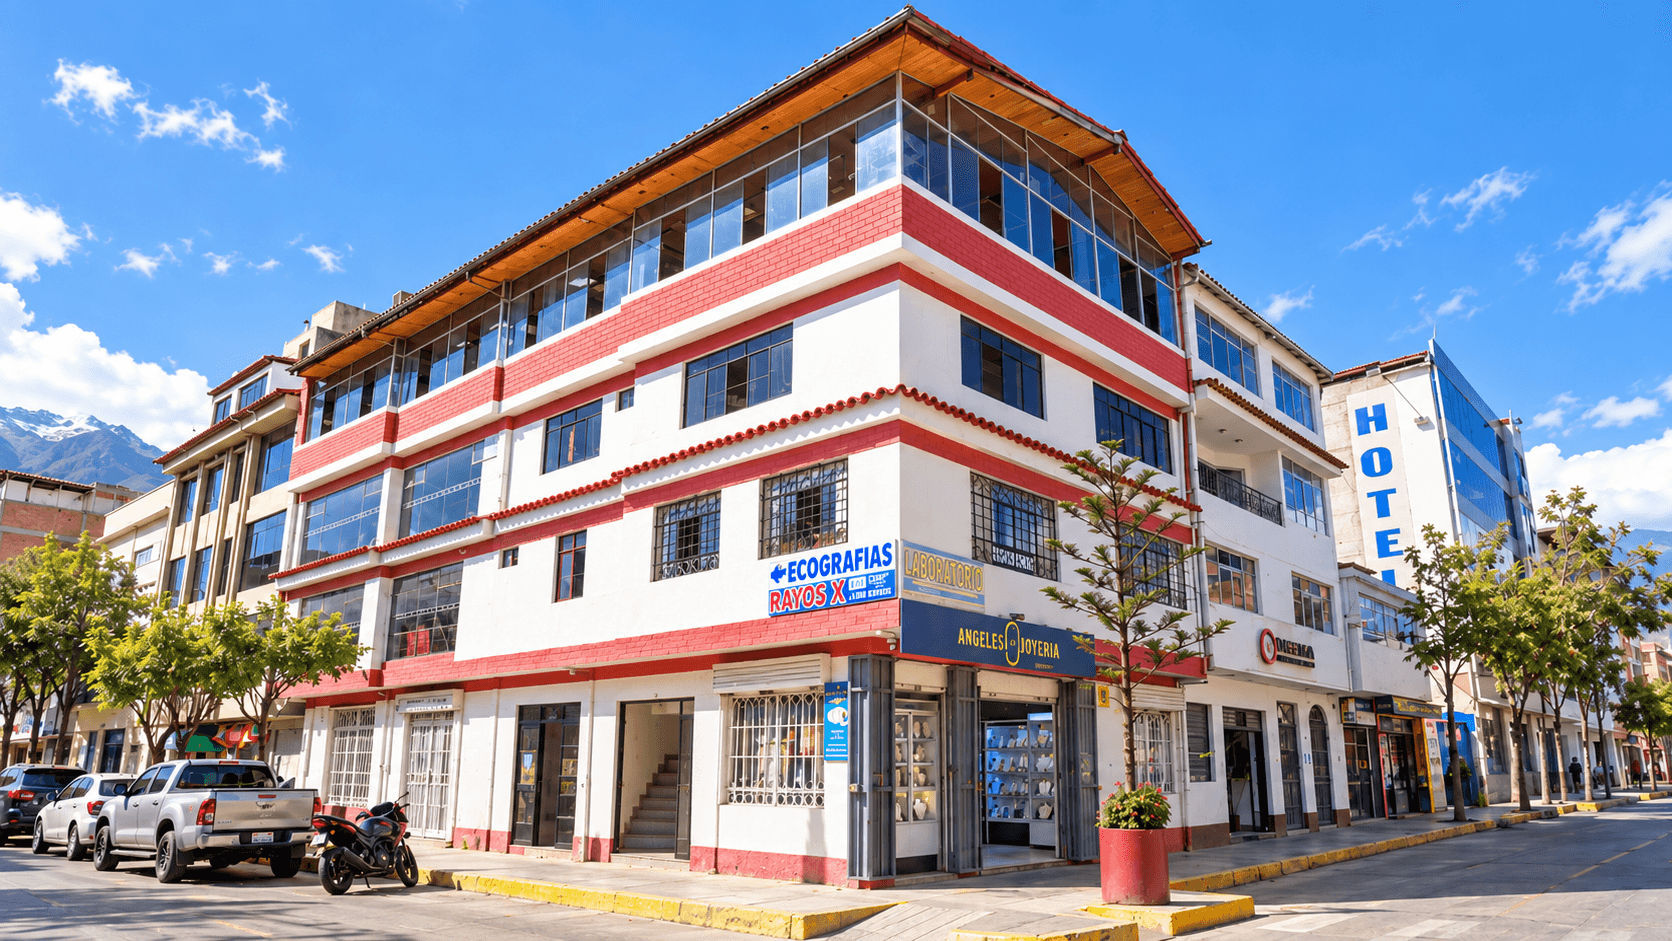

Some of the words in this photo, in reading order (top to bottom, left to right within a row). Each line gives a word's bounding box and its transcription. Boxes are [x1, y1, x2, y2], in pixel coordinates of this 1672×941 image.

[788, 542, 893, 583] ECOGRAFIAS
[904, 549, 984, 593] LABORATORIO
[769, 581, 827, 614] RAYOS
[830, 578, 847, 605] X
[957, 627, 1004, 651] ANGELES
[1019, 636, 1061, 659] JOYERIA
